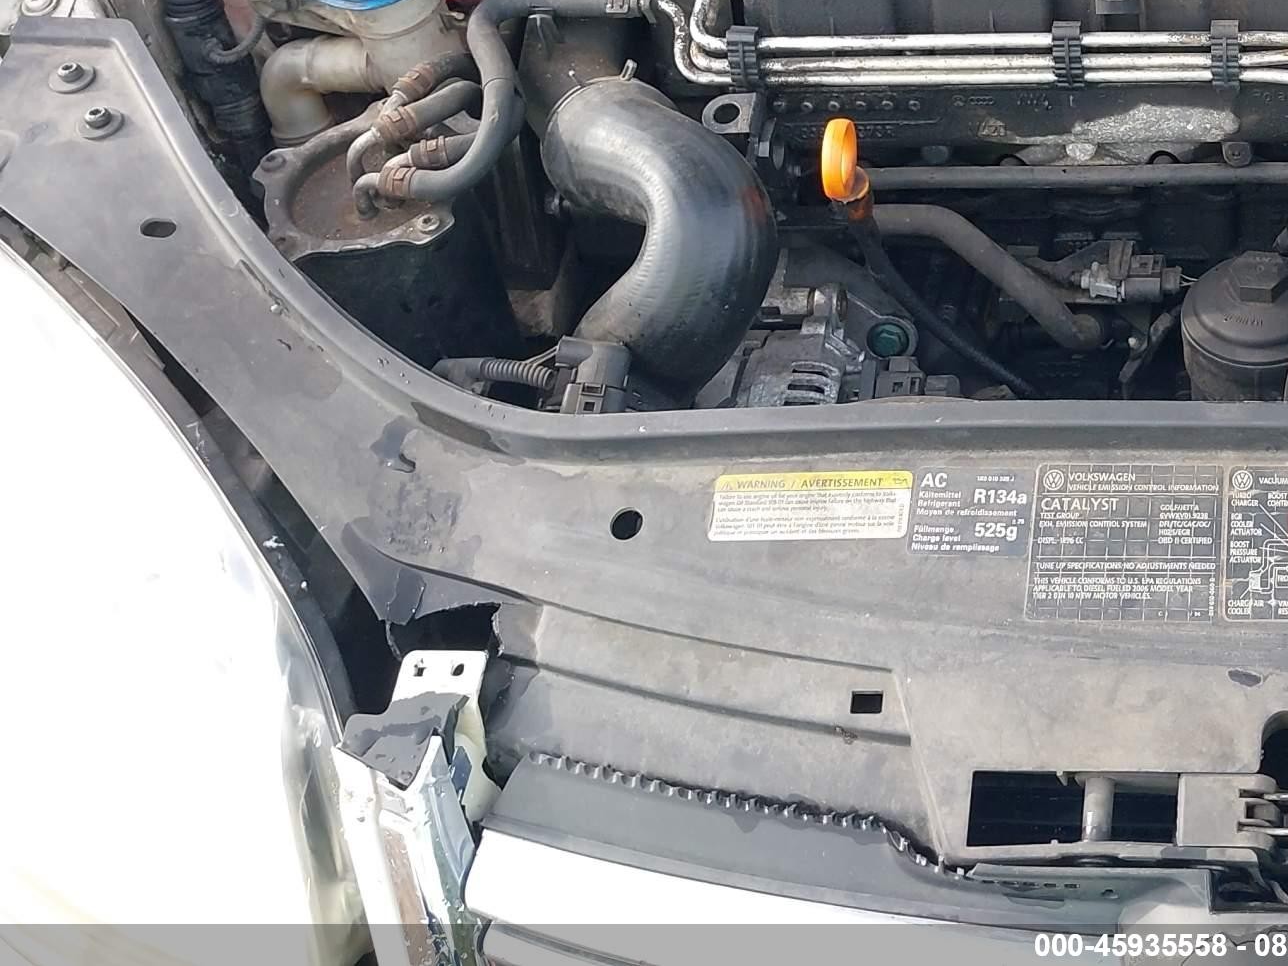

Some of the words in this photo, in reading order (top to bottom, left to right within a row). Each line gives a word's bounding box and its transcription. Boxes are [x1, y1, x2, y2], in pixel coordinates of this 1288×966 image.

[920, 472, 948, 489] AC
[1068, 472, 1136, 482] VOLKSWAGEN
[1259, 477, 1288, 485] VACUUM
[737, 480, 785, 489] WARNING
[801, 478, 883, 489] AVERTISSEMENT
[1067, 483, 1097, 491] VEHICLE
[1098, 483, 1132, 491] EMISSION
[1168, 484, 1219, 492] INFORMATION
[974, 488, 1027, 505] R134a
[918, 499, 961, 508] Refrigerant
[1041, 497, 1119, 511] CATALYST
[917, 508, 943, 517] Moyen
[956, 509, 1018, 517] refroidissement
[1056, 520, 1088, 528] EMISSION
[1089, 520, 1120, 528] CONTROL
[1121, 520, 1147, 528] SYSTEM
[1231, 520, 1254, 528] COOLER
[914, 524, 954, 534] Füllmenge
[974, 522, 1018, 542] 525g
[1230, 528, 1262, 536] ACTUATOR
[912, 534, 940, 543] Charge
[942, 534, 961, 542] level
[1158, 536, 1173, 544] OBD
[911, 542, 938, 552] Niveau
[940, 543, 951, 552] de
[952, 544, 1000, 553] remplissage
[1230, 540, 1250, 548] BOOST
[1230, 548, 1258, 556] PRESSURE
[1036, 562, 1054, 570] TUNE
[1056, 562, 1065, 570] UP
[1136, 562, 1187, 570] ADJUSTMENTS
[1188, 562, 1216, 570] NEEDED
[1034, 577, 1048, 585] THIS
[1050, 577, 1076, 585] VEHICLE
[1077, 577, 1115, 585] CONFORMS
[1116, 577, 1126, 585] TO
[1127, 577, 1140, 585] U.S.
[1141, 577, 1154, 585] EPA
[1155, 577, 1202, 585] REGULATIONS
[1228, 607, 1251, 615] COOLER
